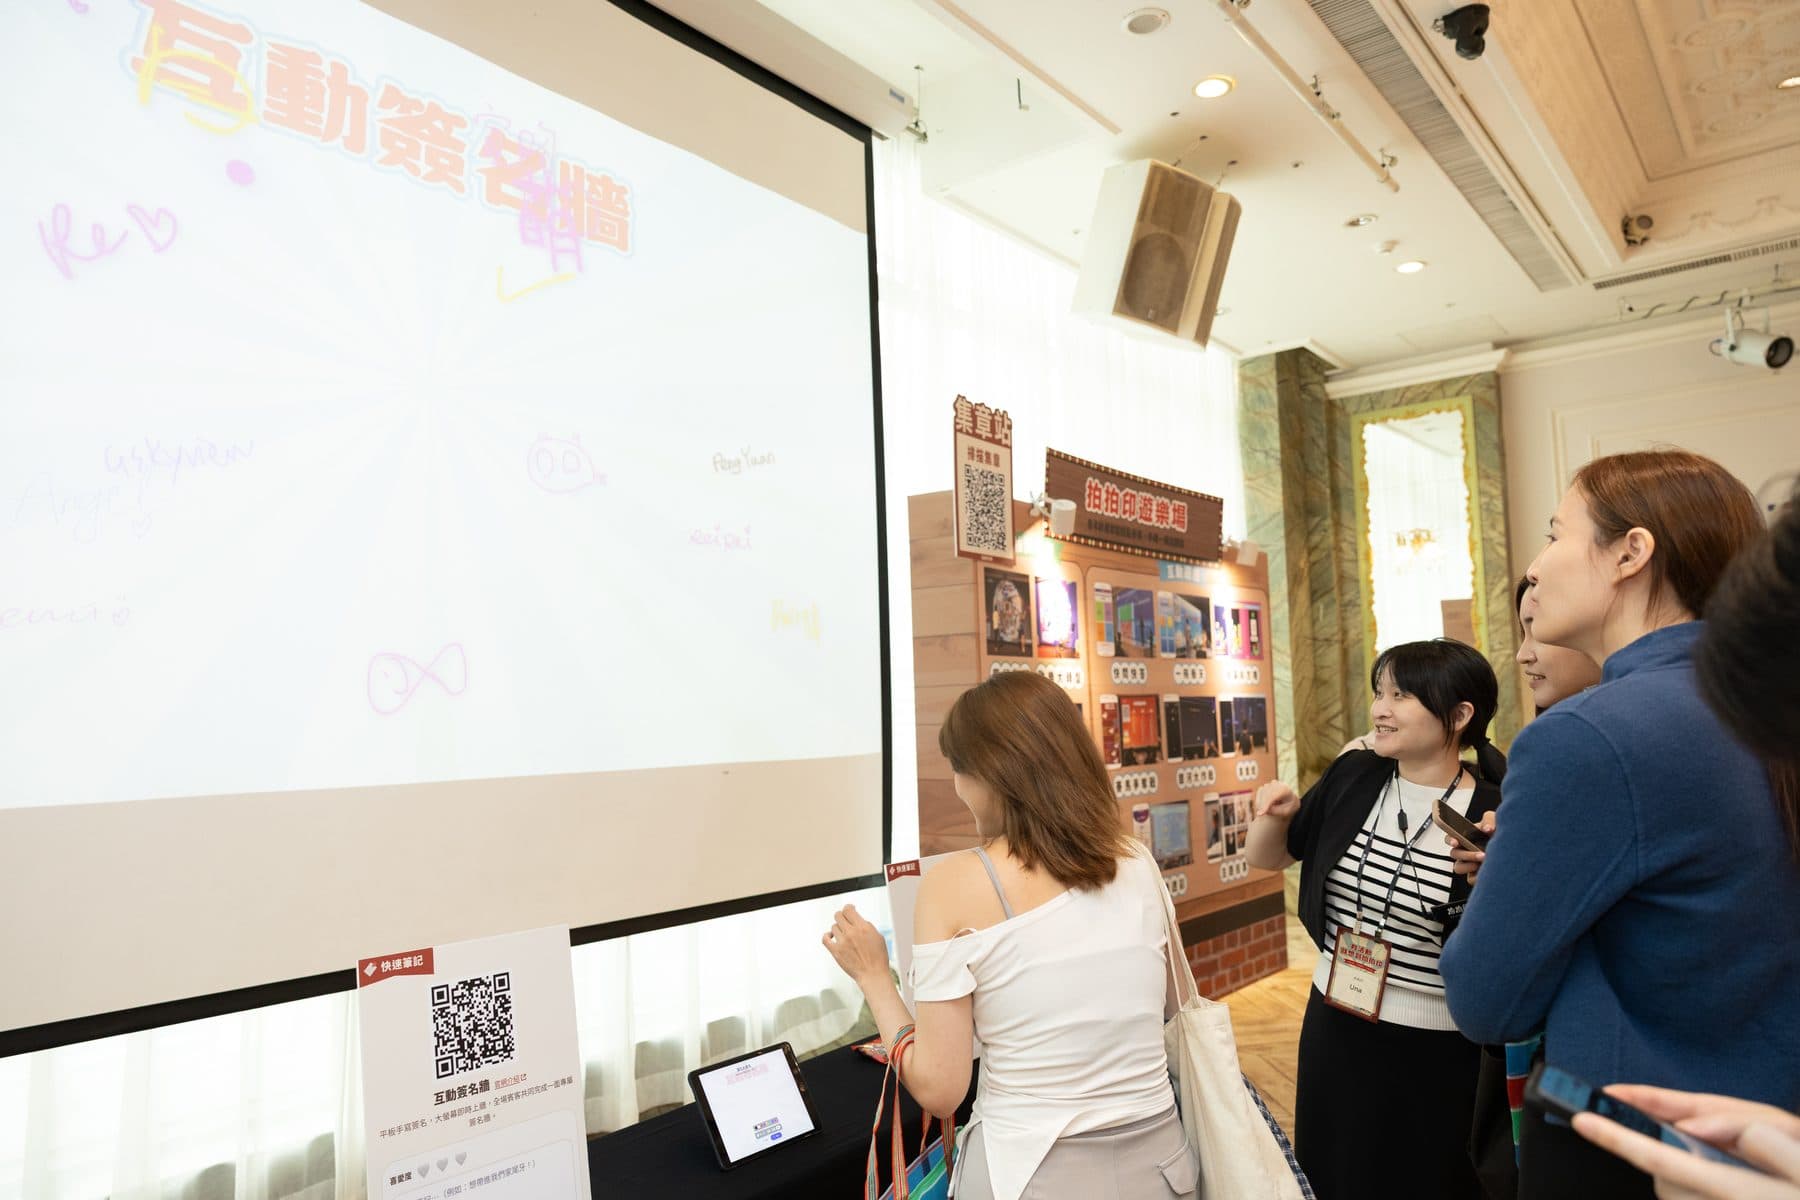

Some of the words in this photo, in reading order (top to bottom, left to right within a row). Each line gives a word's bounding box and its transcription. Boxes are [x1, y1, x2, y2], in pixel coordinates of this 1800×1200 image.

[127, 0, 632, 256] 互動簽名牆
[954, 396, 1011, 445] 集章站
[1086, 478, 1187, 531] 拍拍印遊樂場
[381, 954, 424, 972] 快速筆記
[1349, 984, 1362, 994] Una
[433, 1079, 490, 1106] 互動簽名牆
[389, 1171, 413, 1186] 喜愛度
